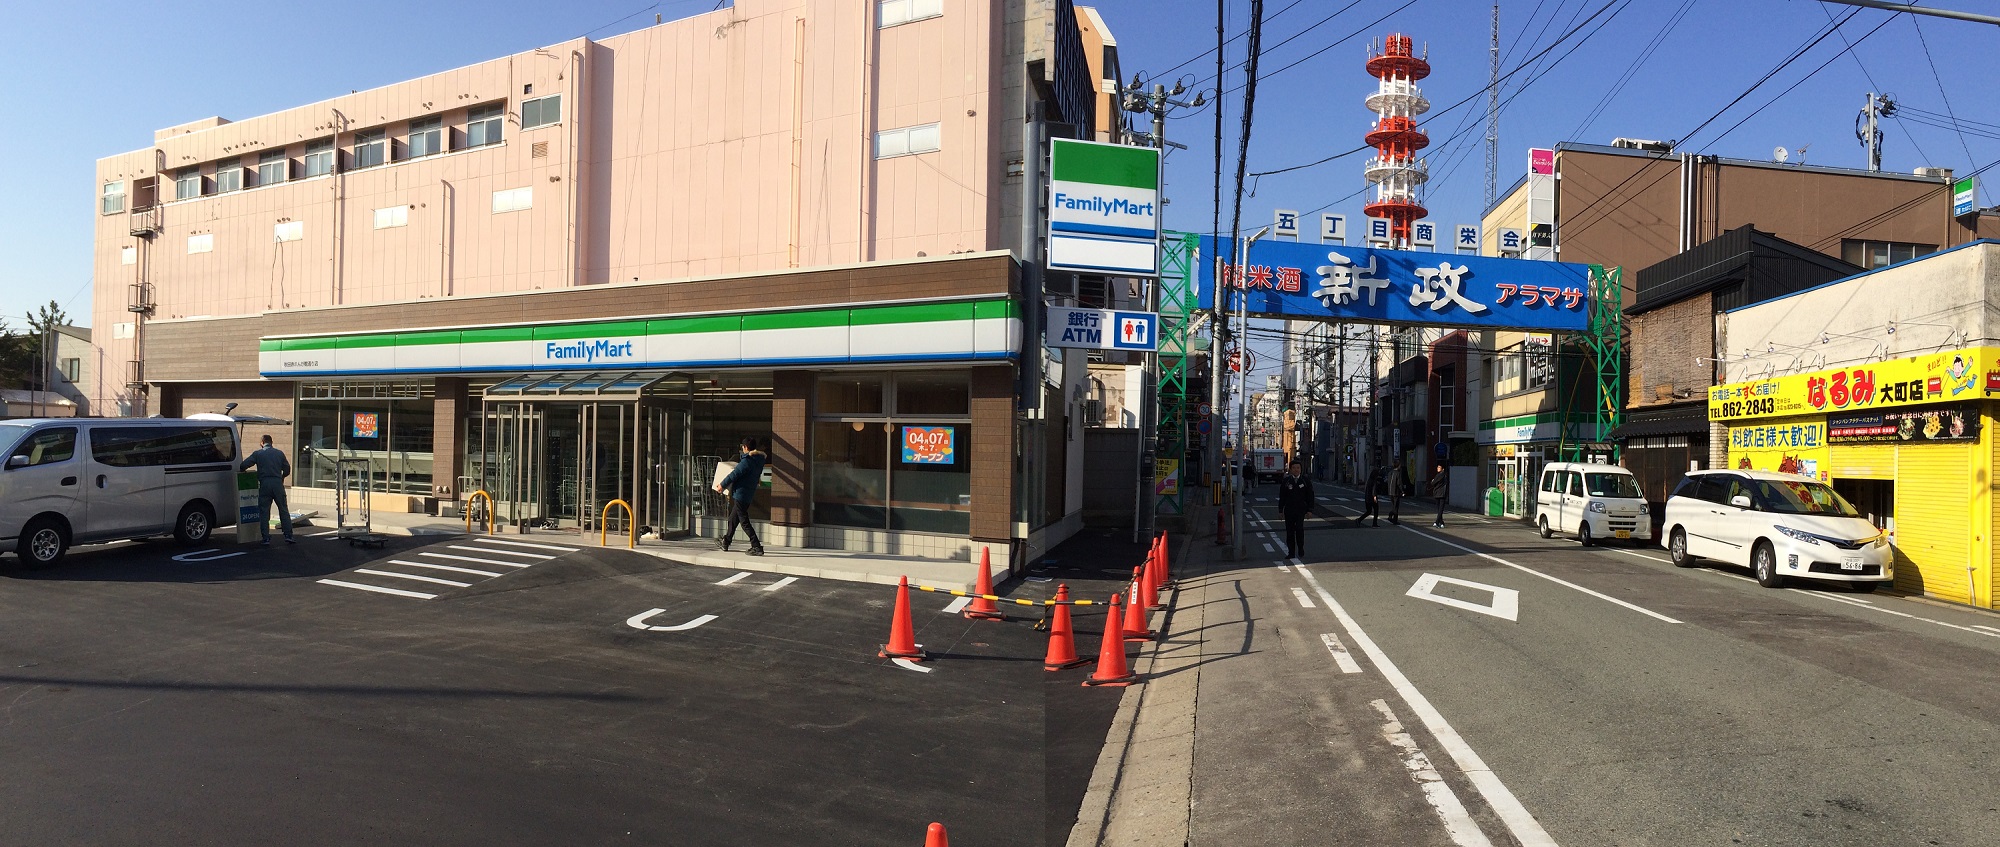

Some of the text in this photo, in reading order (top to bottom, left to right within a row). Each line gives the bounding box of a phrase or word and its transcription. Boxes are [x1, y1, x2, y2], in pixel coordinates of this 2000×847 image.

[1055, 193, 1153, 216] FamilyMart
[1311, 251, 1488, 313] 新政
[1495, 283, 1583, 309] アラマサ
[1068, 312, 1099, 327] 銀行
[1061, 328, 1101, 343] ATM
[547, 340, 632, 362] FamilyMart
[1807, 369, 1923, 410] なるみ 大町店
[1732, 424, 1824, 448] 料飲店様大歓迎!
[912, 453, 944, 462] オープン
